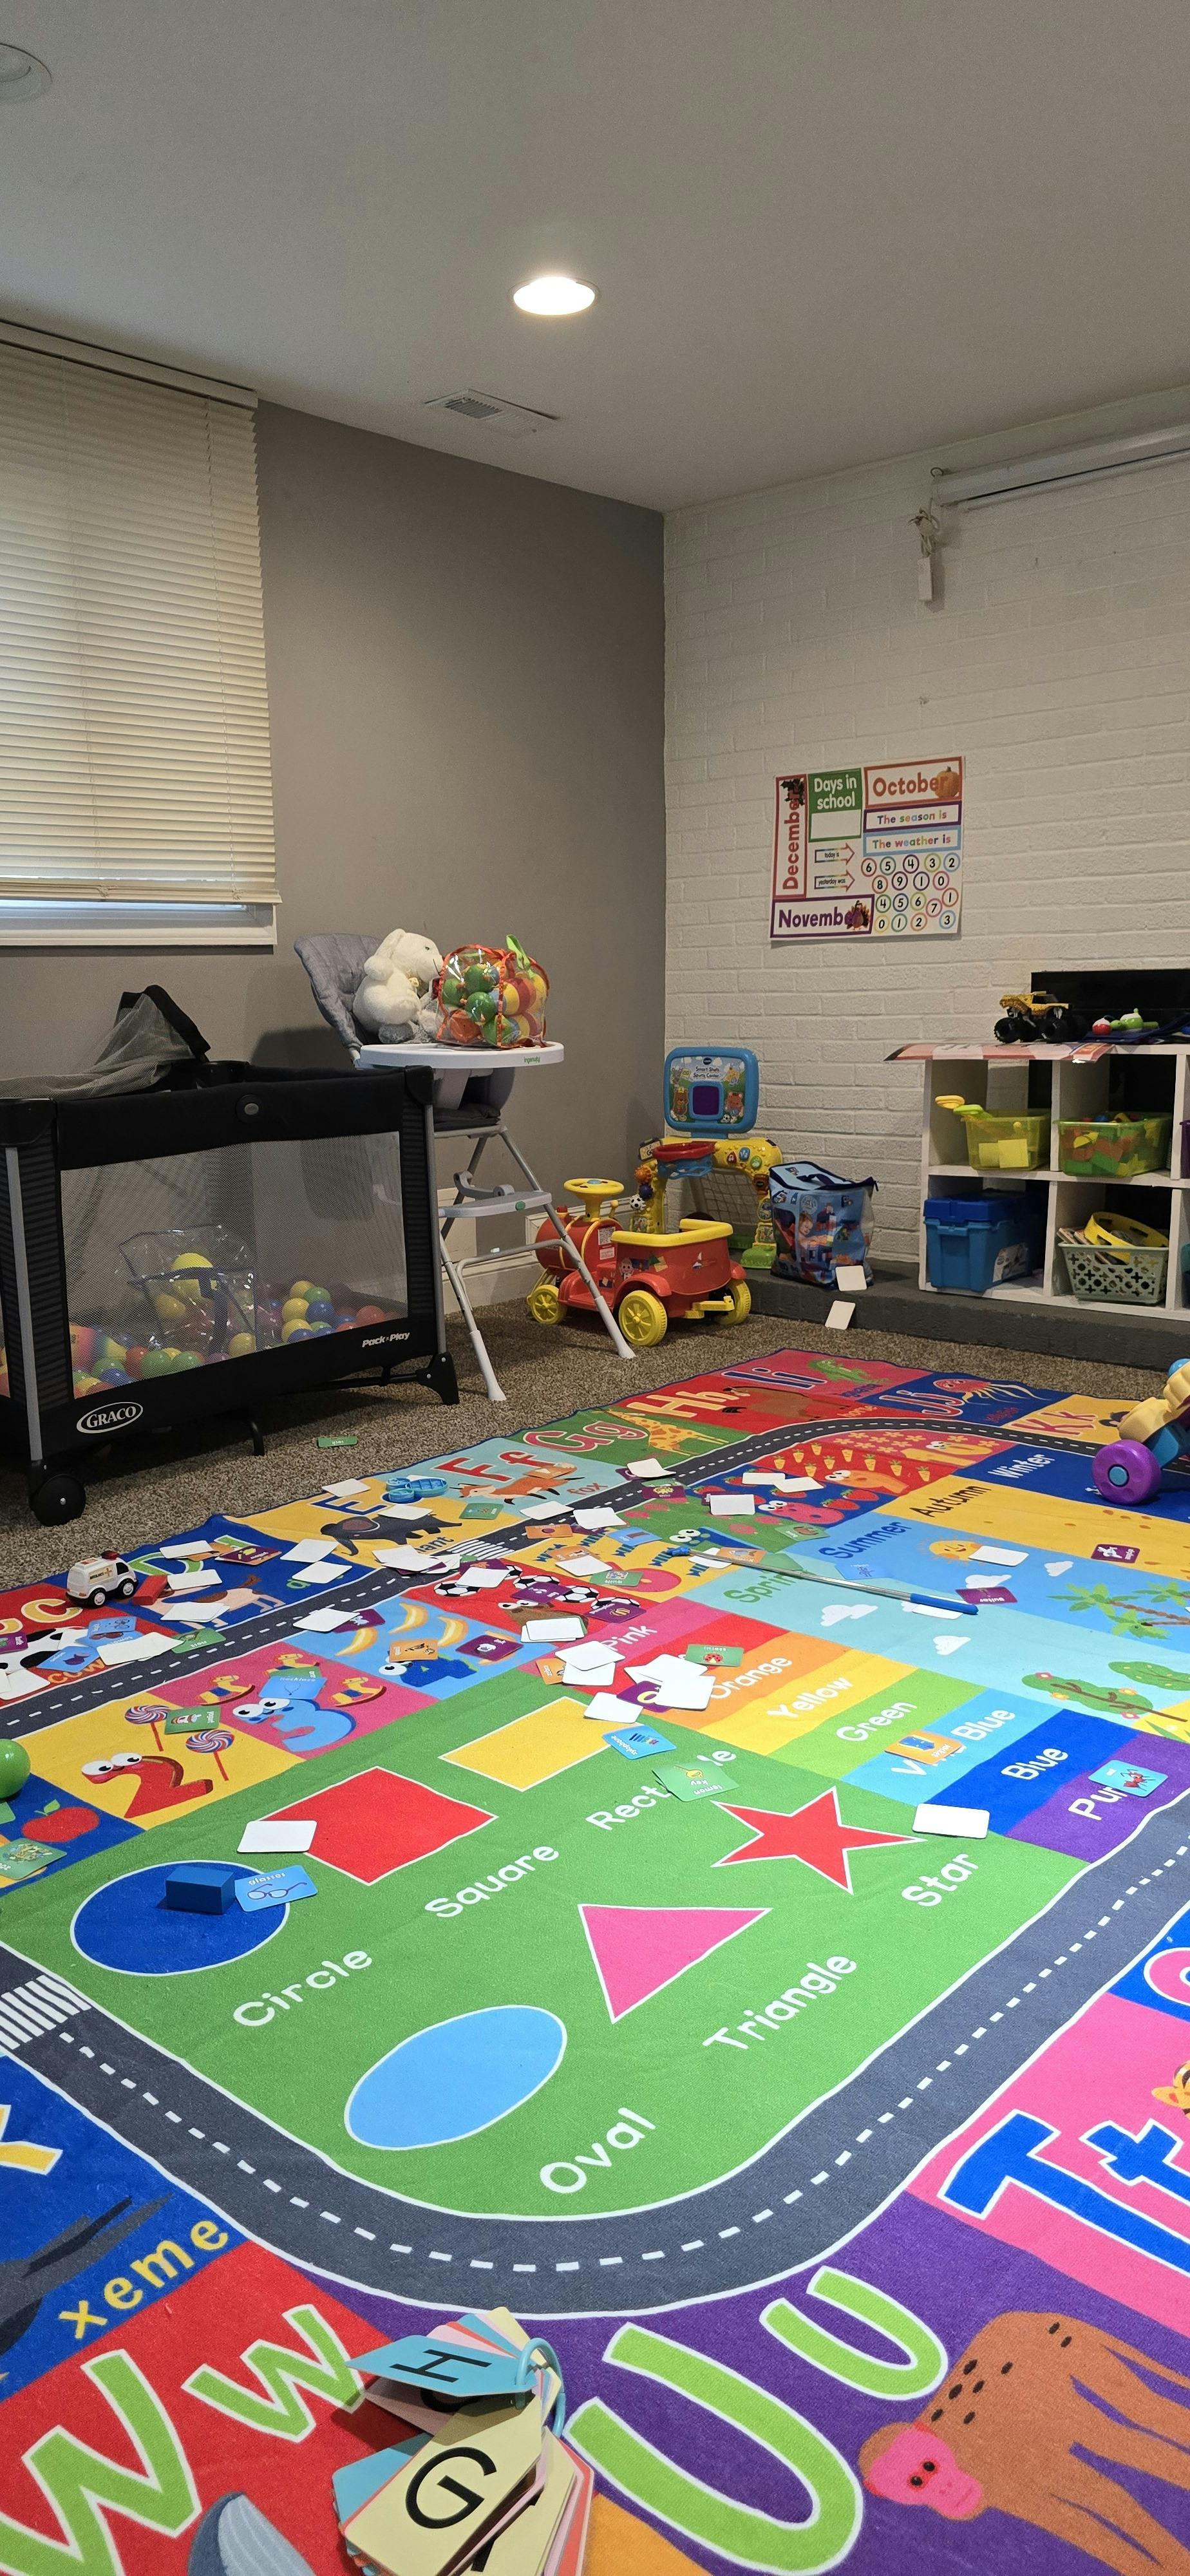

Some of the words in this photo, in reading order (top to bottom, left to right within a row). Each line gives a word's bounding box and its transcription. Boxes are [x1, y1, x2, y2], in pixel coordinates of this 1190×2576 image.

[814, 777, 842, 794] Days
[845, 774, 857, 789] in
[873, 772, 949, 797] October
[817, 792, 856, 810] school
[877, 815, 896, 824] The
[900, 813, 935, 823] season
[939, 810, 947, 820] is
[873, 839, 891, 849] The
[895, 835, 939, 848] weather
[943, 834, 951, 844] is
[866, 863, 872, 872] 6
[885, 862, 891, 871] 5
[908, 859, 914, 869] 4
[929, 858, 936, 867] 3
[949, 858, 955, 867] 2
[877, 880, 883, 889] 8
[897, 876, 903, 886] 9
[920, 876, 923, 886] 1
[938, 876, 944, 886] 0
[880, 899, 886, 909] 4
[898, 898, 903, 907] 5
[915, 896, 921, 906] 6
[949, 892, 952, 902] 1
[779, 907, 860, 928] Novembe
[931, 904, 938, 913] 7
[878, 920, 885, 929] 0
[898, 918, 901, 928] 1
[916, 918, 921, 927] 2
[944, 915, 950, 925] 3
[362, 1335, 385, 1348] Pack
[390, 1332, 410, 1342] Play
[86, 1406, 137, 1428] GRACO
[987, 1453, 1055, 1479] Winter
[567, 1482, 608, 1496] fox
[909, 1485, 992, 1518] Autumn
[818, 1519, 912, 1559] Summer
[723, 1569, 798, 1604] Sprin
[600, 1624, 657, 1653] Pink
[710, 1656, 793, 1700] Orange
[767, 1675, 854, 1719] Yellow
[836, 1700, 918, 1741] Green
[951, 1709, 1015, 1741] Blue
[610, 1734, 639, 1756] xylophone
[1001, 1747, 1069, 1781] Blue
[585, 1749, 737, 1830] Rectle
[694, 1784, 723, 1795] lemon
[1068, 1786, 1128, 1821] Pur
[248, 1871, 287, 1886] glasses
[424, 1845, 559, 1918] Square
[901, 1853, 979, 1907] Star
[233, 1950, 372, 2027] Circle
[702, 1955, 858, 2050] Triangle
[540, 2107, 656, 2193] Oval
[59, 2218, 229, 2340] xeme
[388, 2349, 493, 2383] H
[405, 2446, 497, 2530] G
